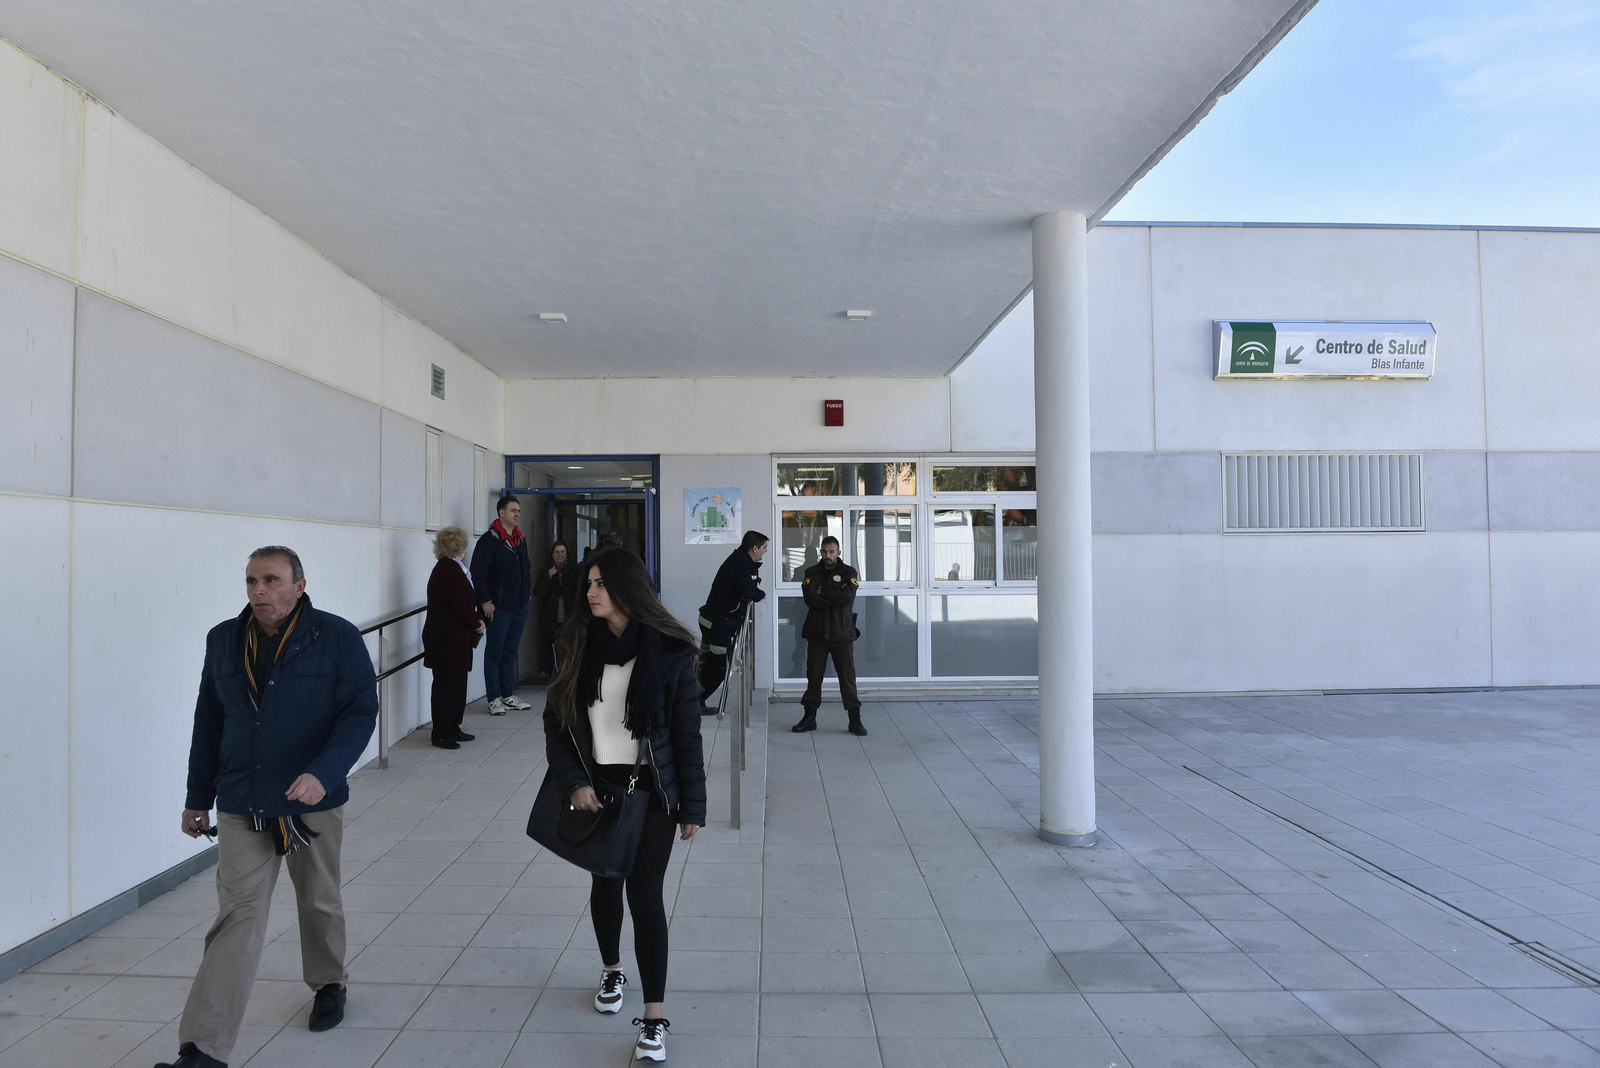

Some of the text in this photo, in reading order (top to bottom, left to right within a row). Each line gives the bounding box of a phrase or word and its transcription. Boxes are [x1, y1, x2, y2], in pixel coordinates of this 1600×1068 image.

[1316, 338, 1427, 355] Centro de Salud
[1371, 358, 1425, 370] Blas Infante
